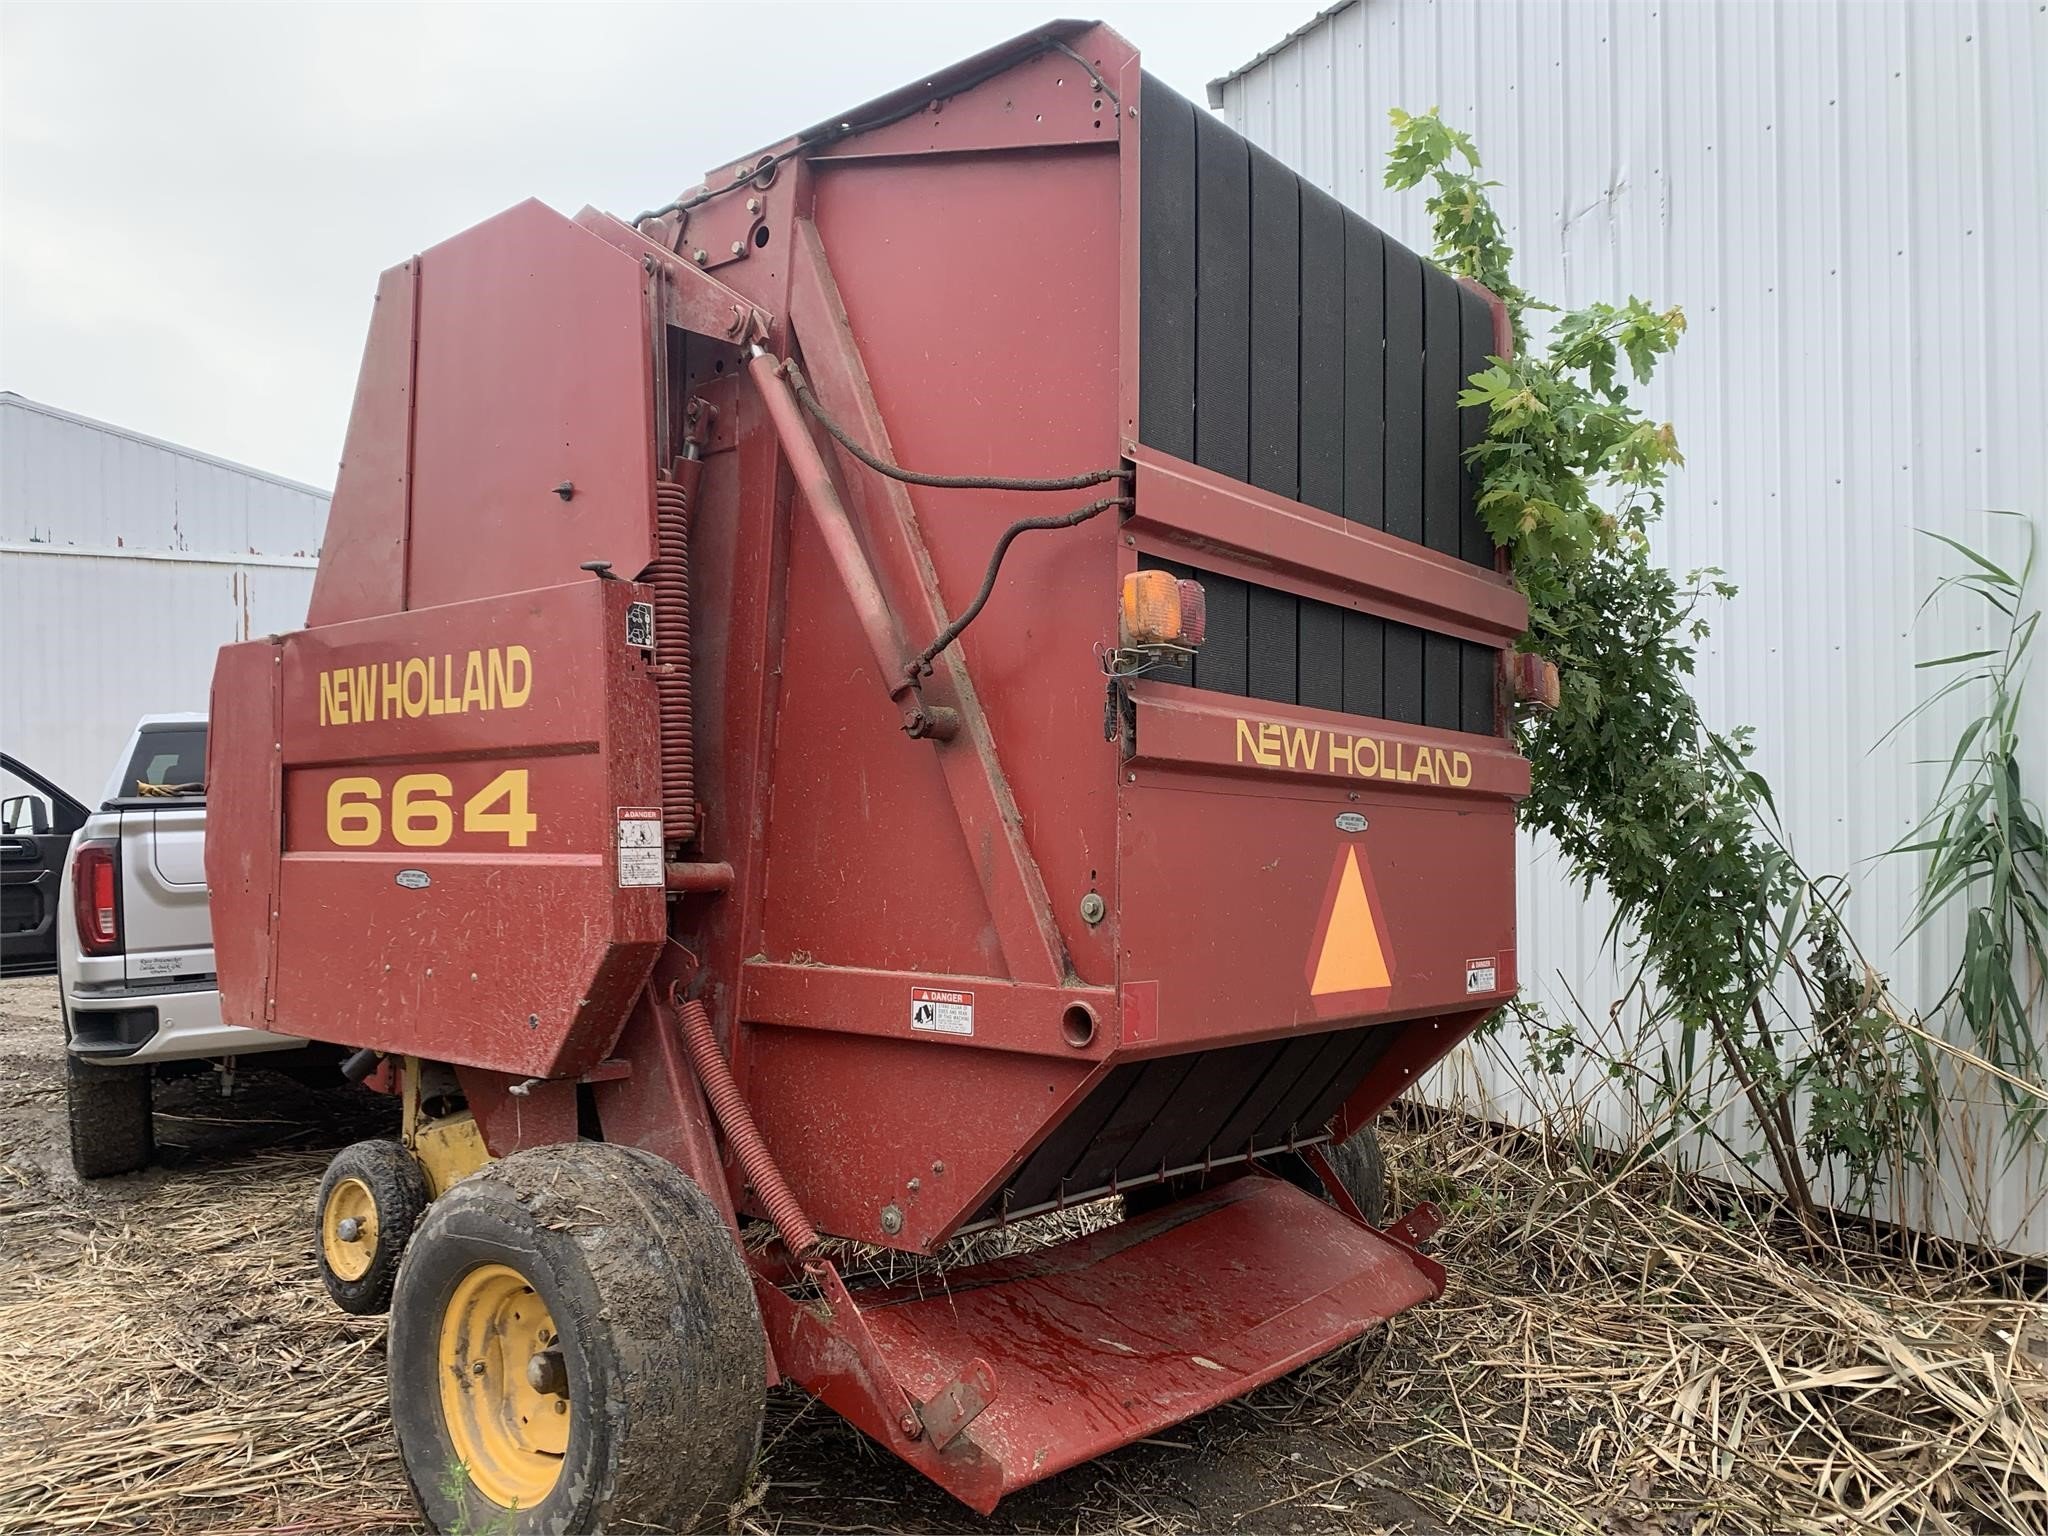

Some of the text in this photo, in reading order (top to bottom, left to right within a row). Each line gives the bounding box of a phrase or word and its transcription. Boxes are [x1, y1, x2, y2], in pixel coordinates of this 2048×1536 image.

[320, 645, 532, 727] NEW HOLLAND
[1236, 719, 1472, 787] NEW HOLLAND
[327, 769, 537, 847] 664
[931, 991, 963, 1003] DANGER
